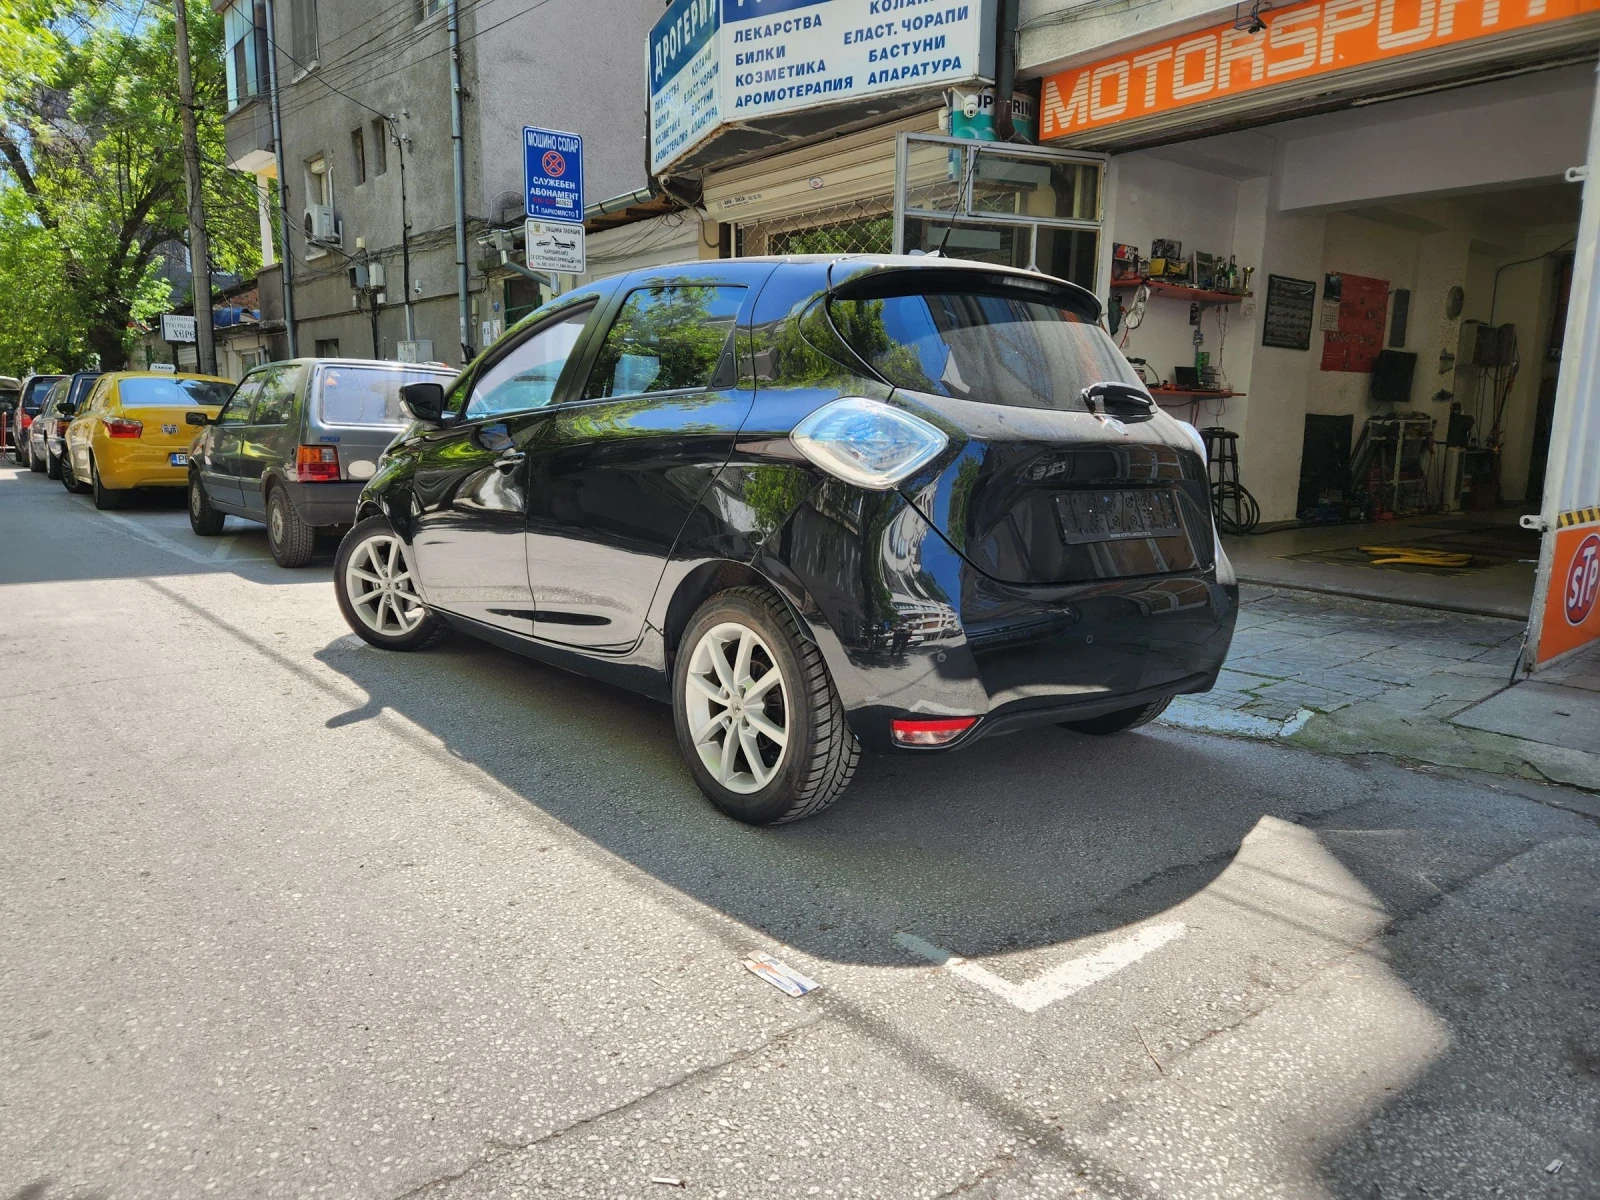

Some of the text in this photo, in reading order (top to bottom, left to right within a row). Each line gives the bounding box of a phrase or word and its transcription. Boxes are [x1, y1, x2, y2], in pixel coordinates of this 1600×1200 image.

[734, 14, 822, 43] ЛЕКАРСТВА
[844, 5, 969, 45] ЕЛАСТ. ЧОРАПИ
[735, 45, 786, 66] БИЛКИ
[868, 35, 946, 62] БАСТУНИ
[735, 59, 826, 87] КОЗМЕТИКА
[867, 56, 962, 85] АПАРАТУРА
[735, 75, 853, 108] АРОМОТЕРАПИЯ
[557, 137, 579, 153] СОЛАР
[530, 187, 579, 201] АБОНАМЕНТ
[532, 176, 576, 190] СЛУЖЕБЕН
[540, 207, 575, 218] ПАРКОМЯСТО
[1568, 546, 1599, 608] STP
